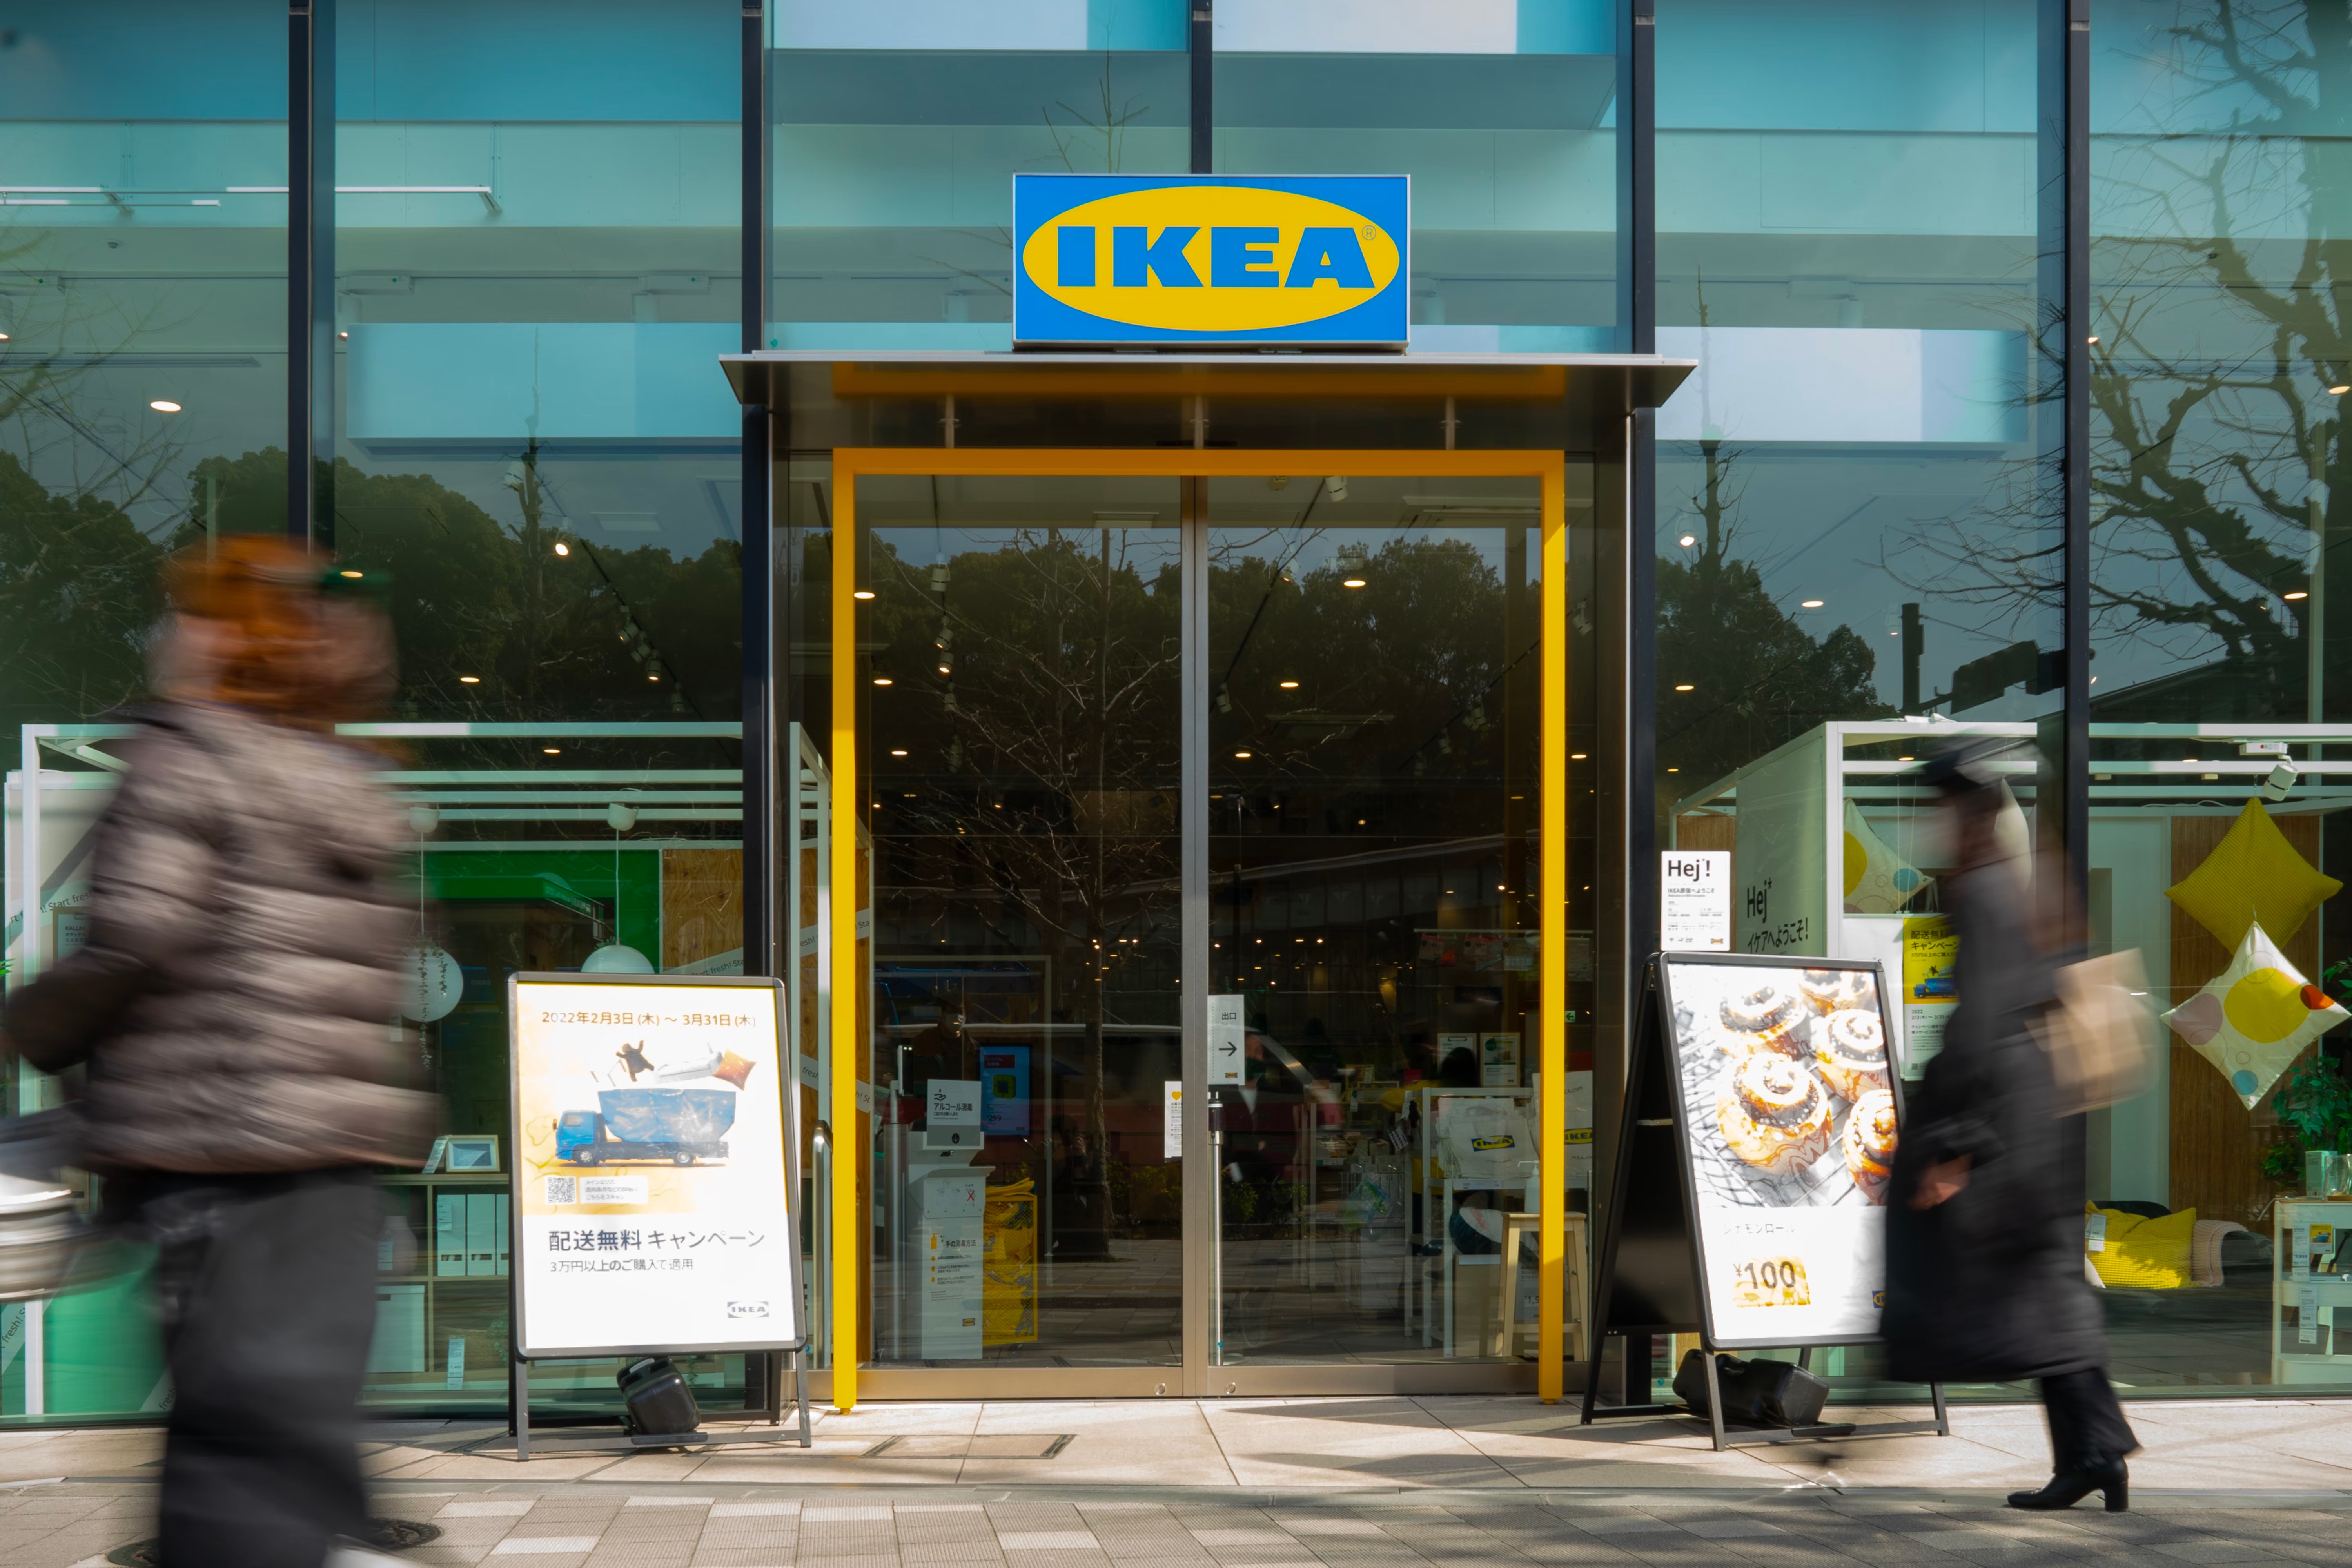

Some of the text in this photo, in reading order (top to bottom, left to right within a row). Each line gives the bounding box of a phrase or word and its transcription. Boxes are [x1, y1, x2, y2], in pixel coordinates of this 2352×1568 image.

[1057, 225, 1376, 288] IKEA
[858, 920, 870, 929] Sta
[800, 936, 816, 946] esh!
[710, 962, 731, 974] fresh!
[1221, 1012, 1237, 1020] 出口
[1564, 1086, 1583, 1094] EA.com
[934, 1103, 973, 1112] アルコール消毒
[945, 1239, 976, 1248] 手の消毒方法
[1524, 1296, 1539, 1305] ¥1,9
[2, 1316, 23, 1343] fresh!
